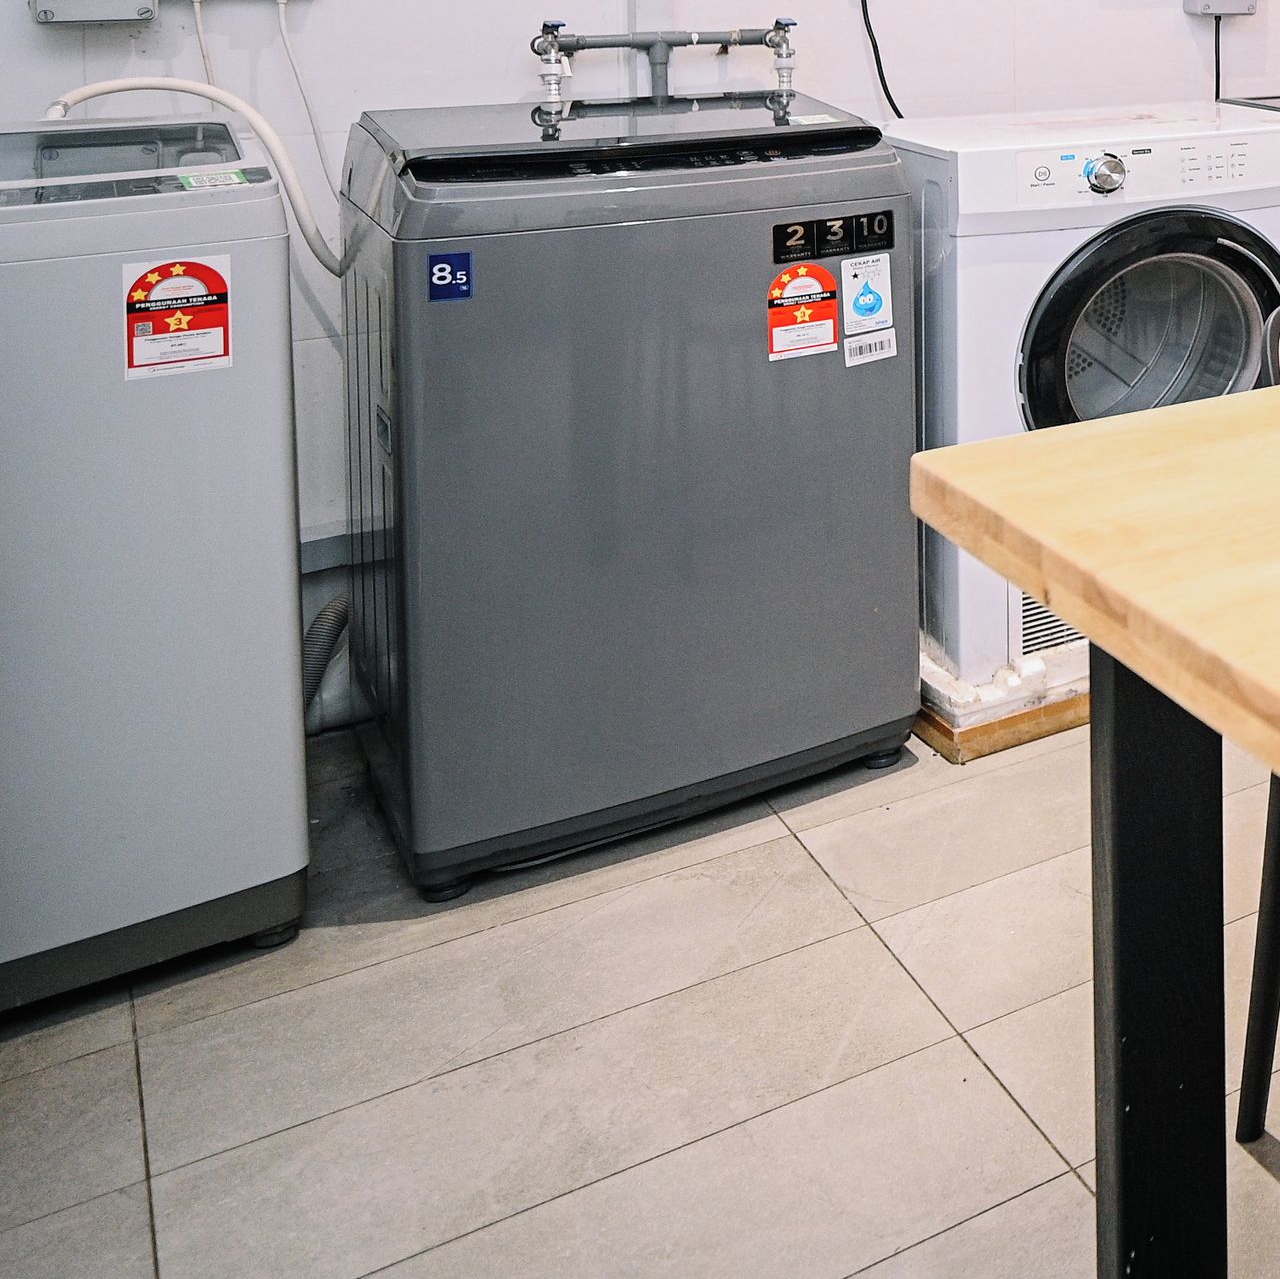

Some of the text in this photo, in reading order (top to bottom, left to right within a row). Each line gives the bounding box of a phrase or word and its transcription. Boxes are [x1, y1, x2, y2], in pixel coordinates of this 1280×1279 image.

[786, 214, 888, 246] 2 3 10
[431, 263, 468, 285] 8.5
[135, 295, 218, 309] PENGGUNAAN TENAGA
[773, 295, 809, 305] PENGGUNAAN
[174, 317, 182, 326] 3
